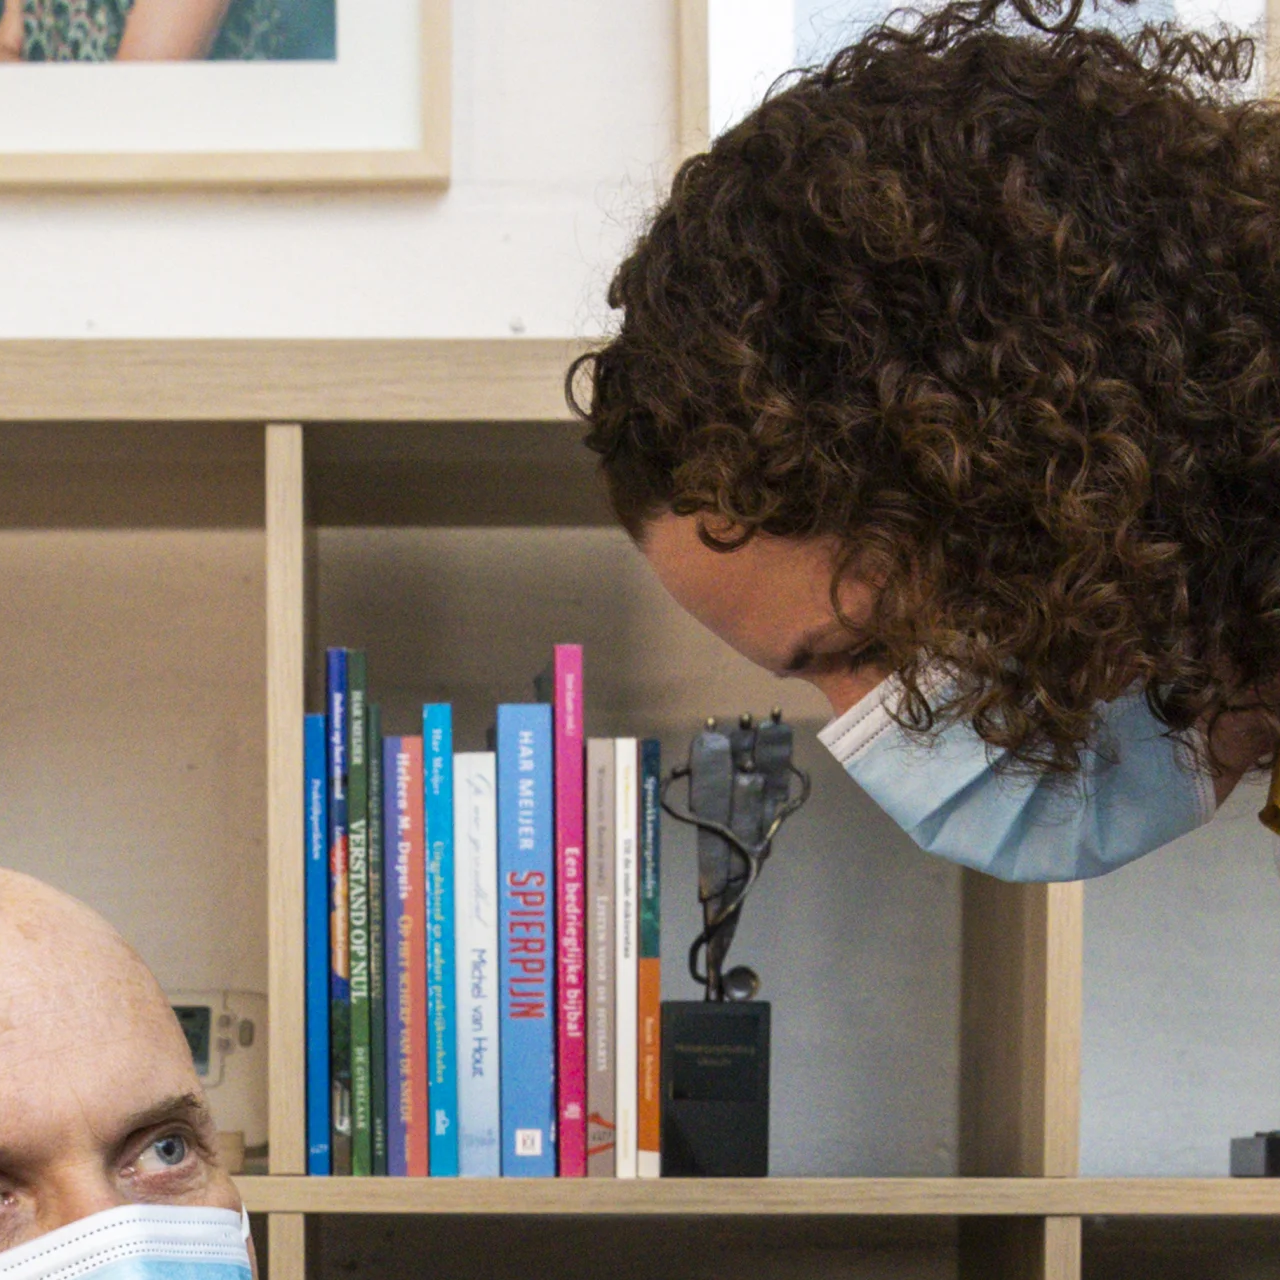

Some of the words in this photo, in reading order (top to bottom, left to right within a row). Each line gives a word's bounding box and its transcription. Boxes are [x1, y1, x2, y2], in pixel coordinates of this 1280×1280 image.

[518, 730, 535, 772] HAR
[396, 752, 412, 810] Heleen
[397, 815, 413, 836] M.
[518, 778, 535, 851] MEIJER
[349, 818, 368, 927] VERSTAND
[394, 842, 413, 900] Dupuis
[564, 847, 581, 878] Een
[349, 929, 368, 957] OP
[508, 870, 546, 1019] SPIERPIJN
[560, 882, 582, 985] bedrieglijke
[349, 961, 368, 1004] NUL
[472, 948, 489, 999] Michel
[472, 1005, 485, 1032] van
[562, 988, 583, 1038] bijbal
[472, 1037, 489, 1078] Hout
